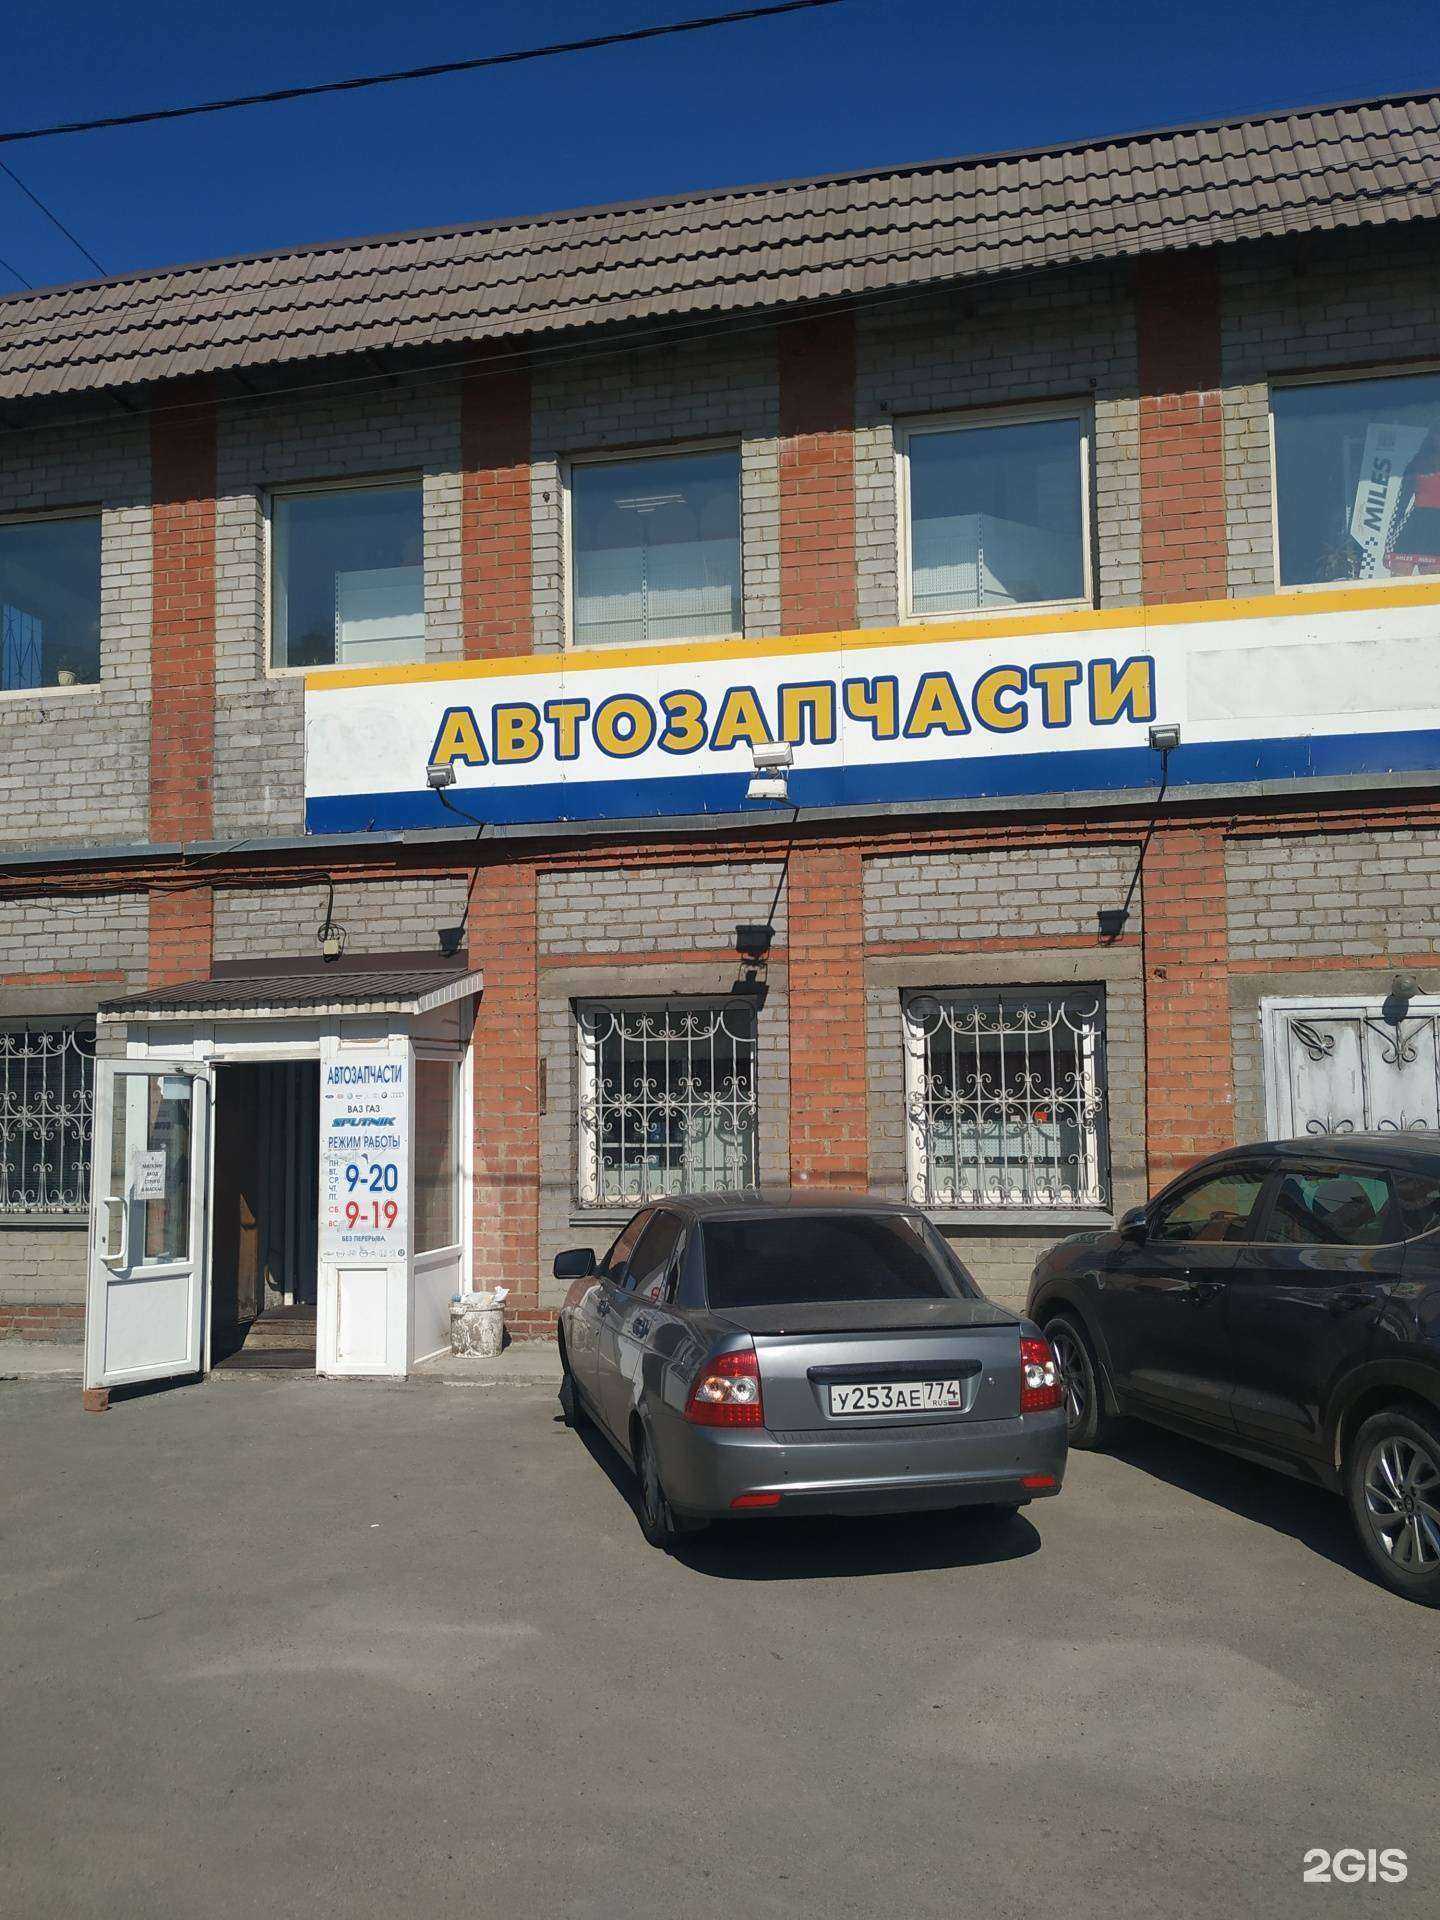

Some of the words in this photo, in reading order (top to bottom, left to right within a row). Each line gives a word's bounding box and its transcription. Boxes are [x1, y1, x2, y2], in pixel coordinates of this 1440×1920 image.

[1363, 457, 1392, 531] MILES
[429, 655, 1156, 767] АВТОЗАПЧАСТИ
[327, 1064, 402, 1084] АВТОЗАПЧАСТИ
[347, 1105, 363, 1113] ВАЗ
[366, 1105, 381, 1113] ГАЗ
[332, 1117, 396, 1127] SPUTNIK
[328, 1136, 361, 1148] РЕЖИМ
[363, 1135, 401, 1148] РАБОТЫ
[345, 1163, 398, 1192] 9-20
[345, 1200, 398, 1228] 9-19
